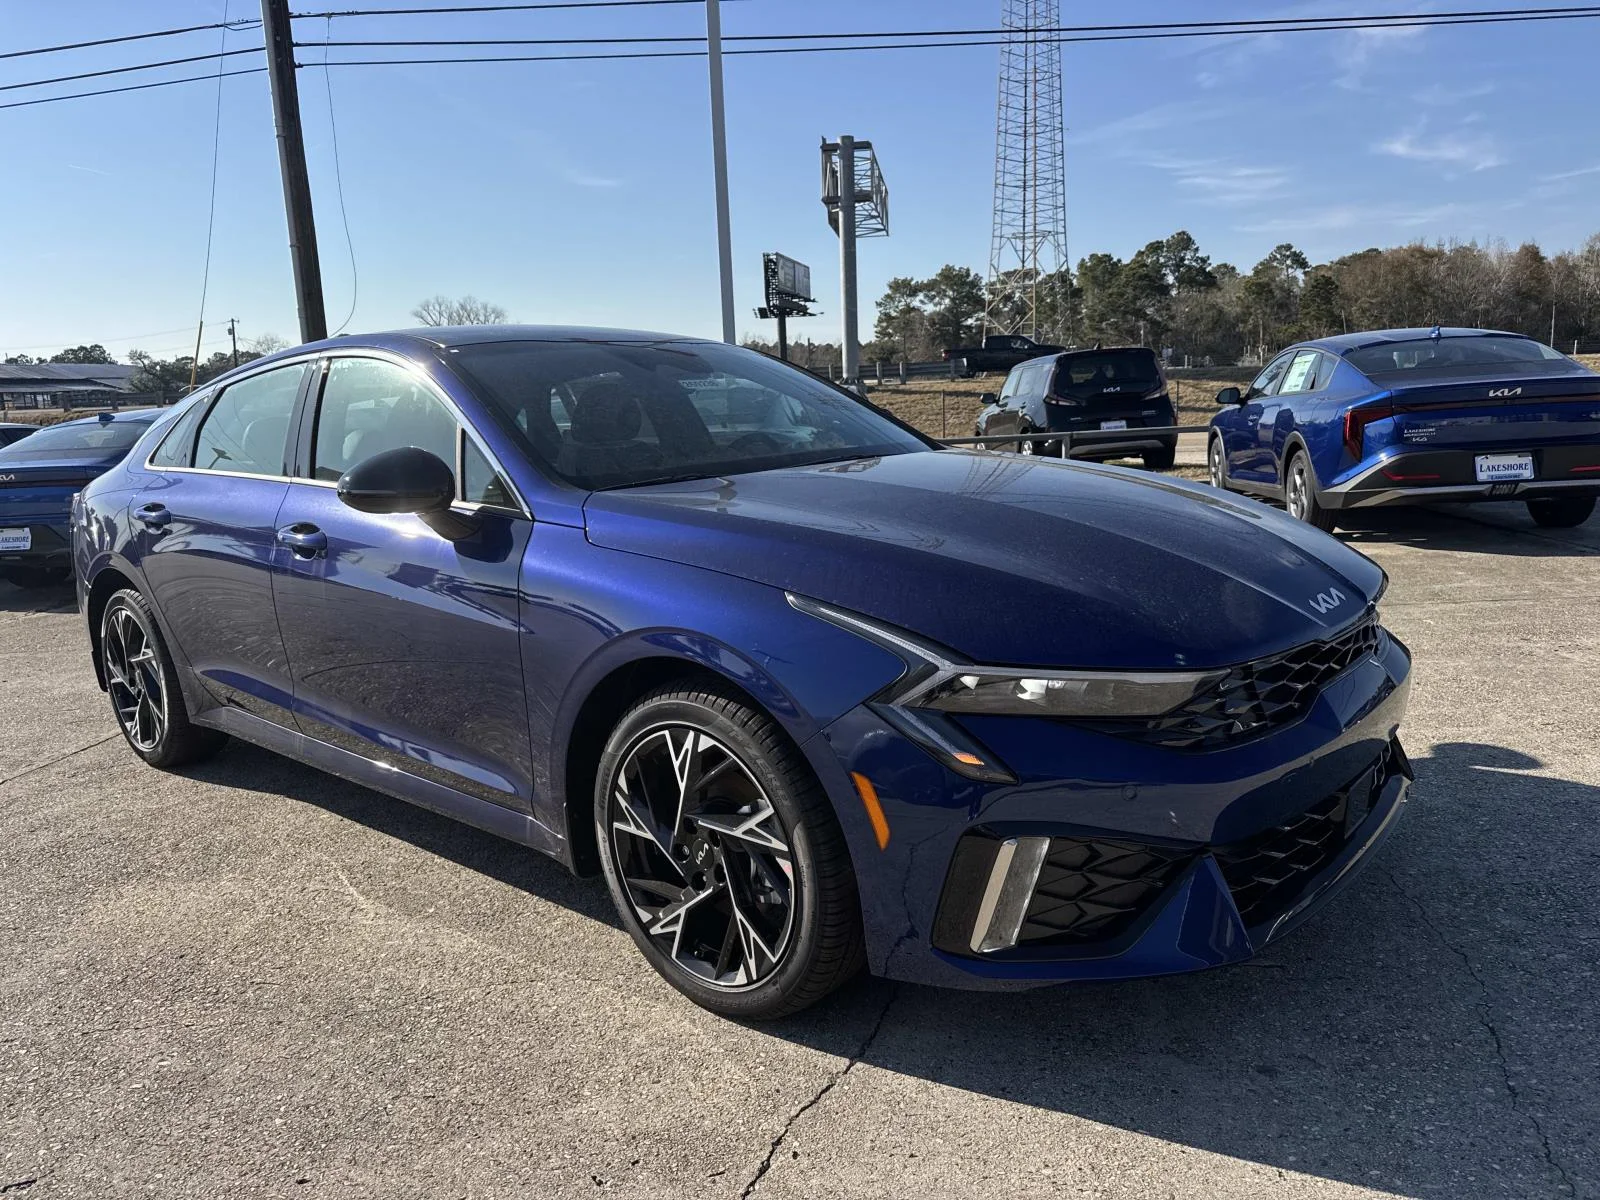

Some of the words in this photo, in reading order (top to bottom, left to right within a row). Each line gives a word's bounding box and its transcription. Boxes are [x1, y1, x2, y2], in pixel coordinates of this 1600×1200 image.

[1489, 388, 1522, 396] KIA
[1480, 463, 1529, 473] LAKESHORE
[1308, 587, 1346, 614] KIA
[695, 842, 709, 865] KIA
